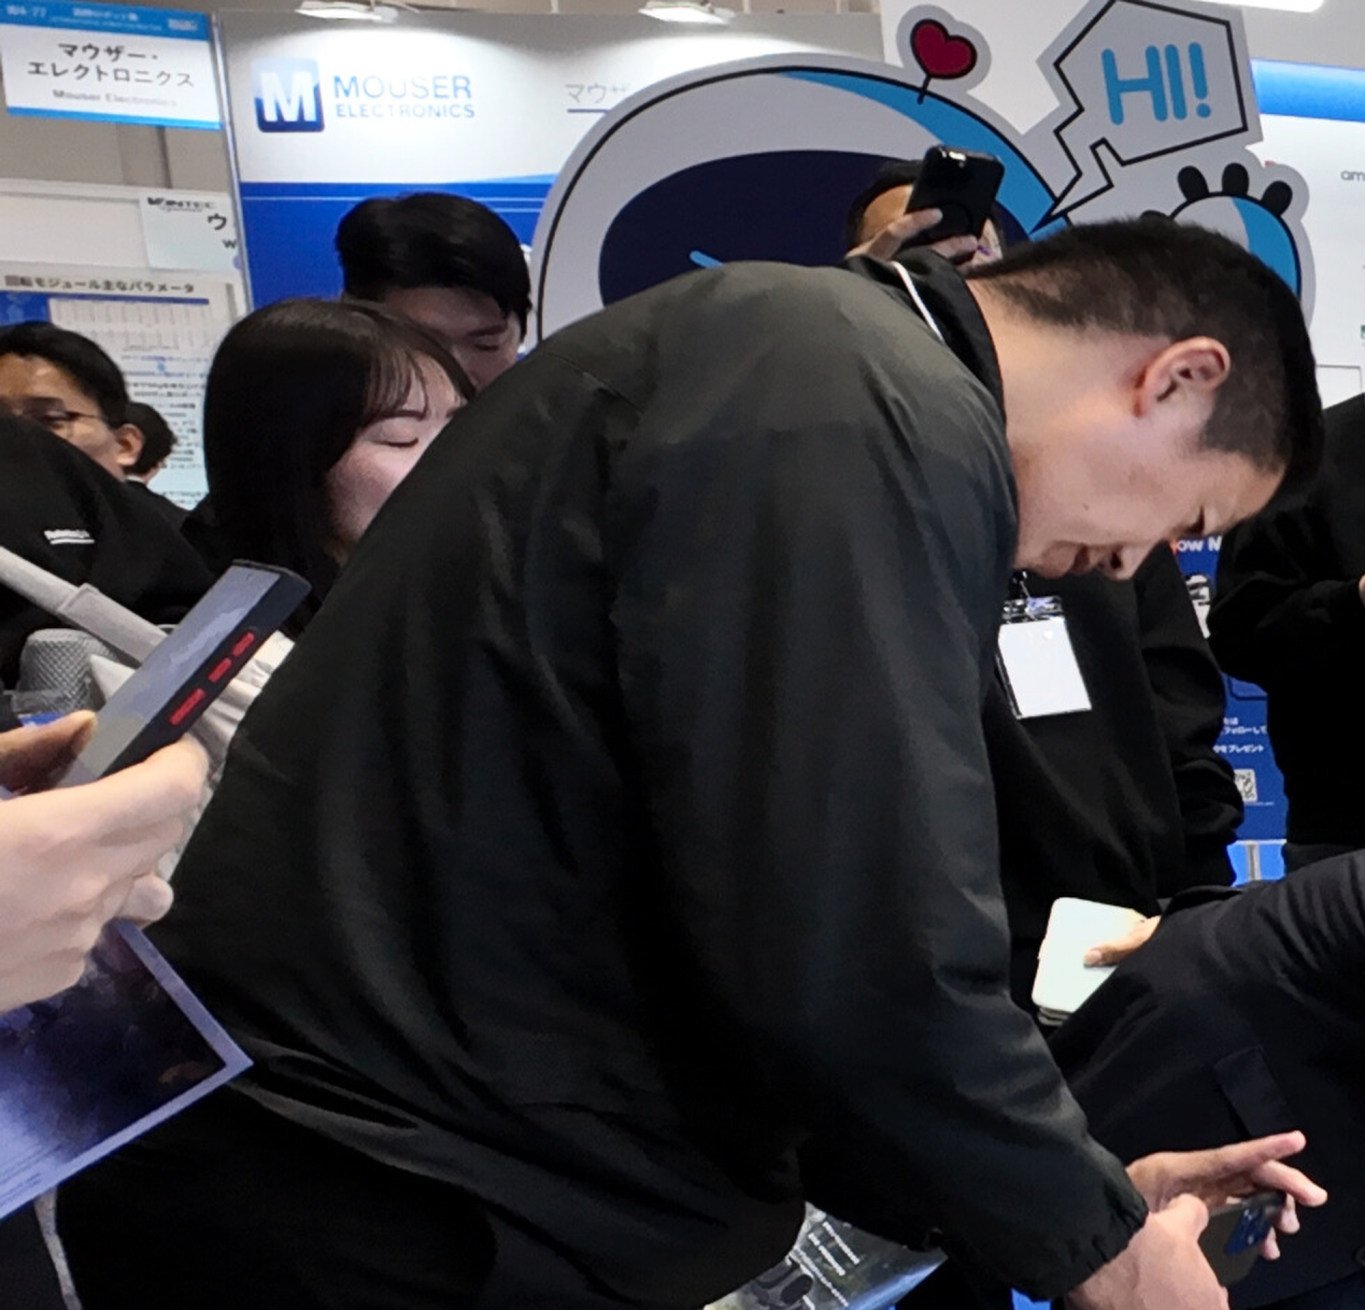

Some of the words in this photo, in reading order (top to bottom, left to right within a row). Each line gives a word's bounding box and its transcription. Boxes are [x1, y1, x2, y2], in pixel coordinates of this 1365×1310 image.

[28, 61, 194, 87] エレクトロニクス
[1101, 42, 1212, 125] HI!
[334, 75, 472, 100] MOUSER
[336, 103, 475, 119] ELECTRONICS
